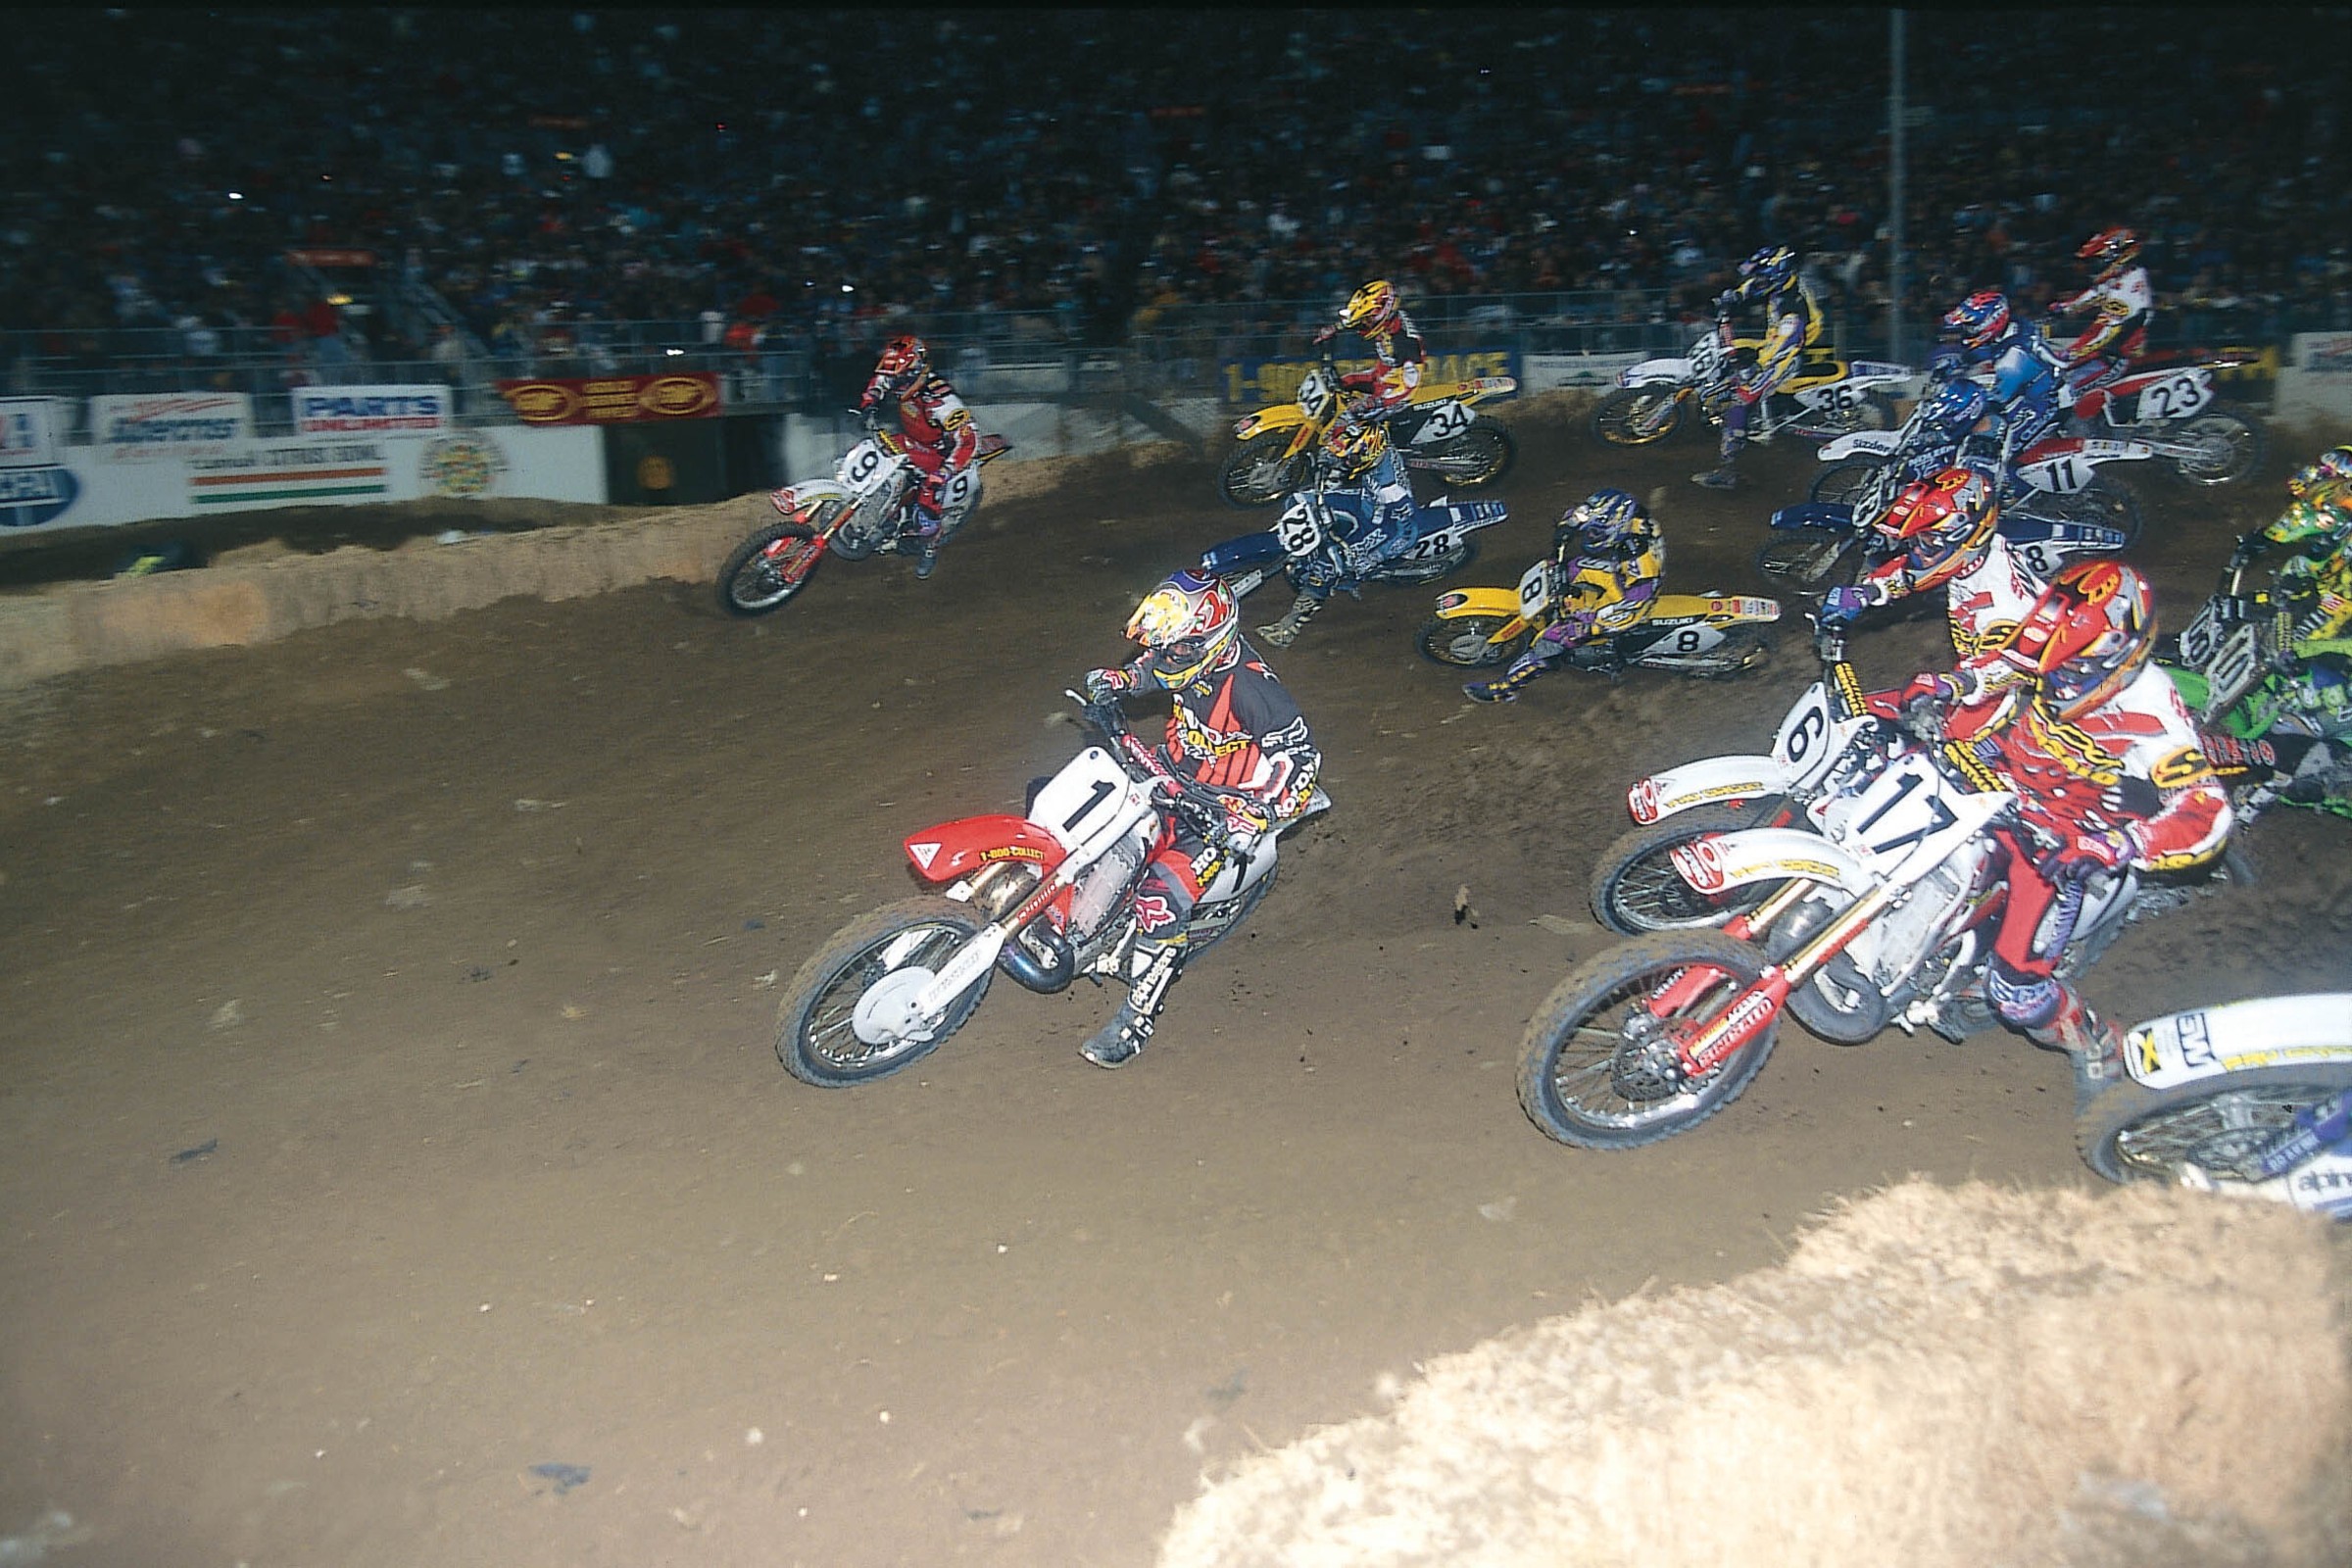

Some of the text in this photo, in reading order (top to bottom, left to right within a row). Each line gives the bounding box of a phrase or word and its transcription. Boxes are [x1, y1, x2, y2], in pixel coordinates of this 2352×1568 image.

[1413, 400, 1448, 412] SUZUKI
[1817, 384, 1853, 413] 36
[2151, 378, 2201, 417] 23
[1431, 407, 1469, 438] 34
[852, 450, 880, 483] 9
[2046, 462, 2079, 490] 11
[952, 474, 969, 503] 9
[1282, 509, 1318, 553] 28
[1414, 533, 1451, 560] 28
[1522, 575, 1543, 604] 8
[1651, 616, 1694, 628] SUZUKI
[1676, 630, 1699, 653] 8
[1787, 706, 1824, 762] 6
[1062, 779, 1117, 833] 1
[1856, 771, 1960, 855] 17
[980, 846, 1045, 862] 1-800-COLLECT
[1231, 854, 1249, 894] 1
